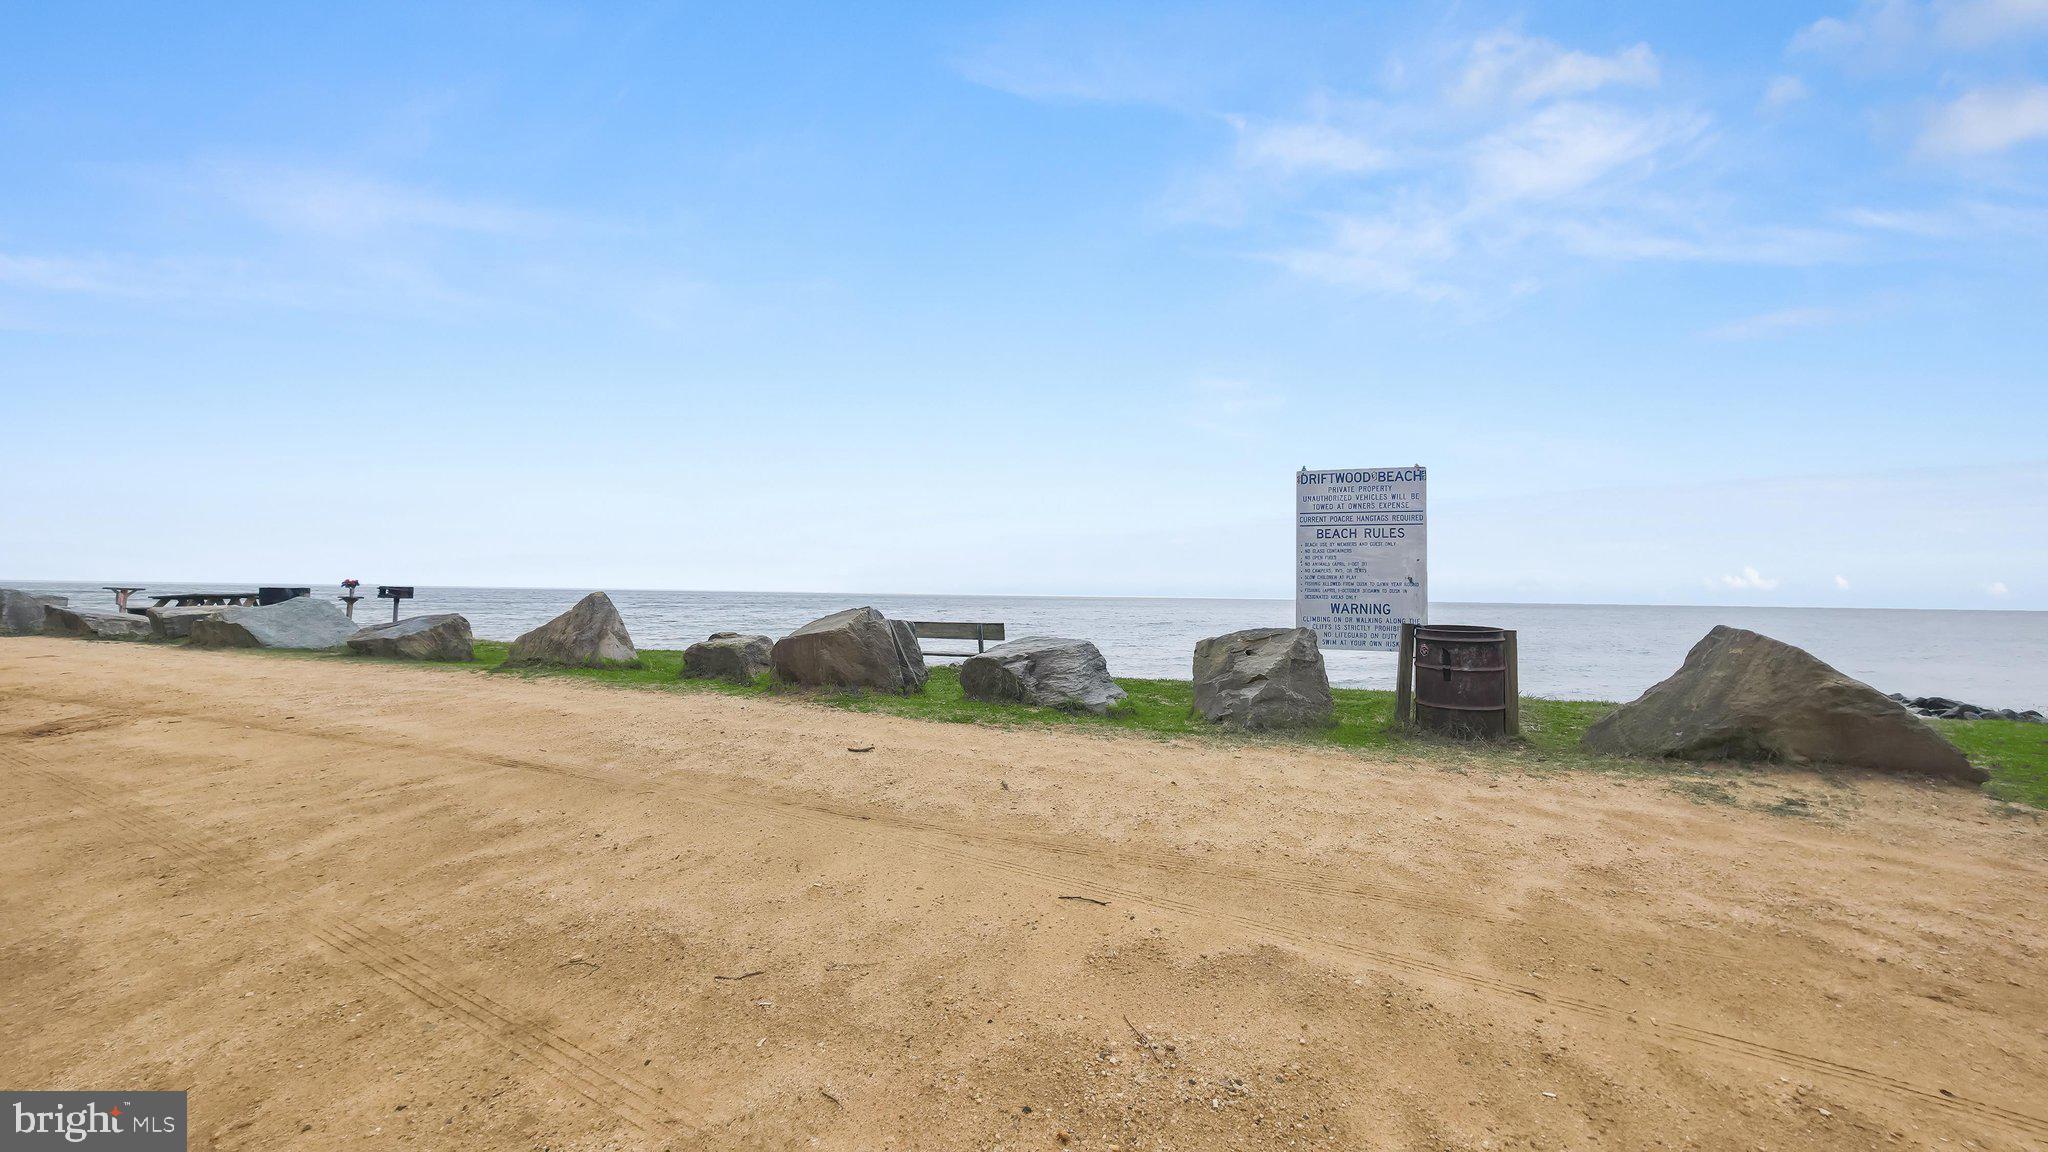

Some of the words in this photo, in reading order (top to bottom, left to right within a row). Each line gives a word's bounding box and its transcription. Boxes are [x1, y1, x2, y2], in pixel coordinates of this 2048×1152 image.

[1300, 472, 1371, 484] DRIFTWOOD
[1378, 470, 1422, 482] BEACH
[1302, 494, 1352, 502] UNAUTHORIZED
[1317, 529, 1357, 539] BEACH
[1364, 528, 1405, 538] RULES
[1331, 603, 1391, 614] WARNING
